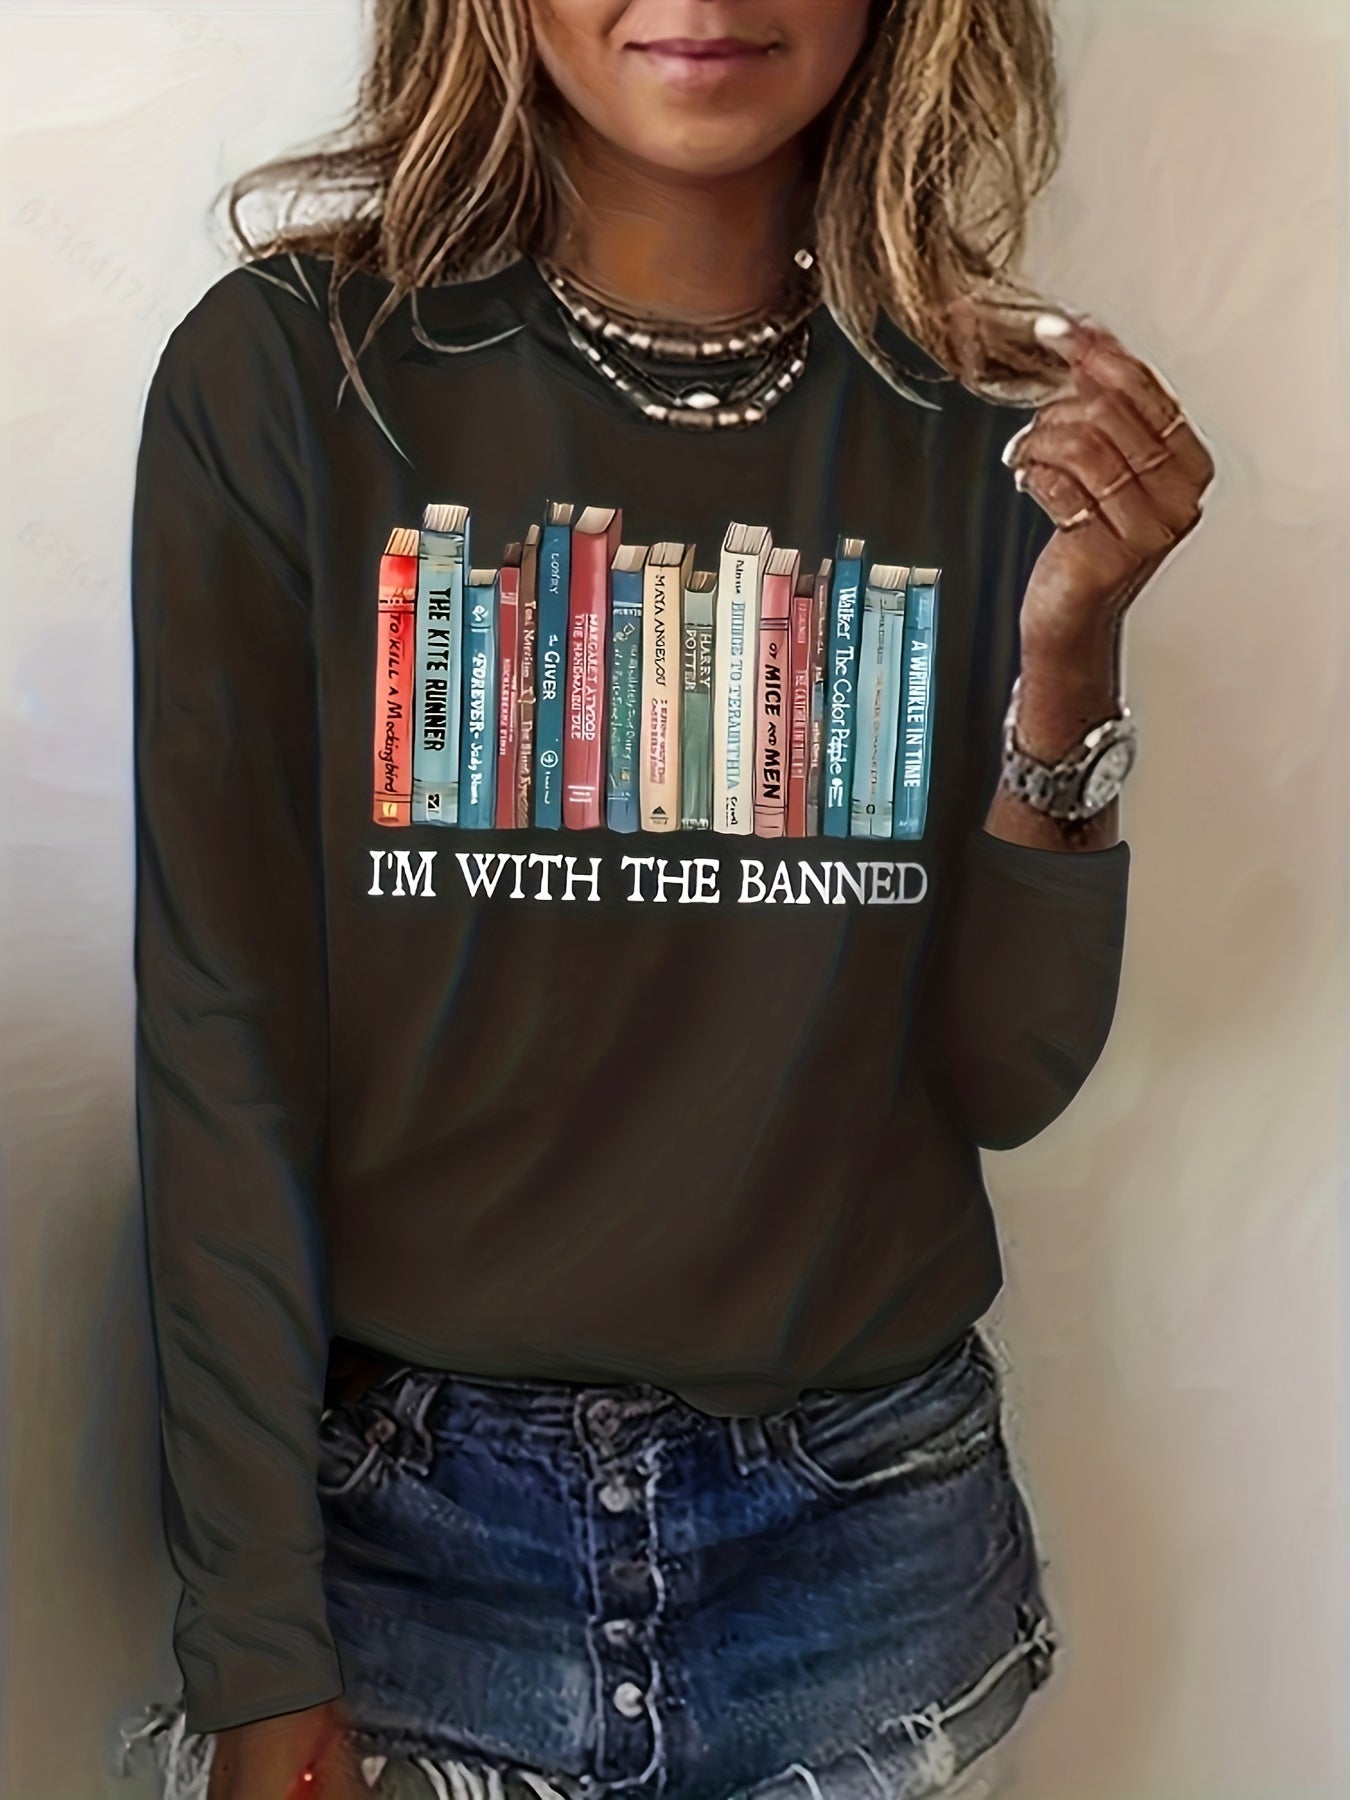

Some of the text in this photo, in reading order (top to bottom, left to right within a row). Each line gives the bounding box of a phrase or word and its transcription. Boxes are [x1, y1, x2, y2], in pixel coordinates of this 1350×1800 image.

[654, 575, 666, 615] MAYA
[389, 639, 401, 679] KILL
[424, 588, 451, 751] THE KITE RUNNER
[542, 650, 560, 701] GIVER
[699, 633, 712, 688] HARRY
[835, 646, 855, 676] The
[388, 686, 399, 696] A
[764, 664, 782, 717] MICE
[831, 678, 852, 726] Color
[903, 640, 928, 788] A WRINKLE IN TIME
[762, 748, 781, 800] MEN
[368, 851, 927, 904] I'M WITH THE BANNED
